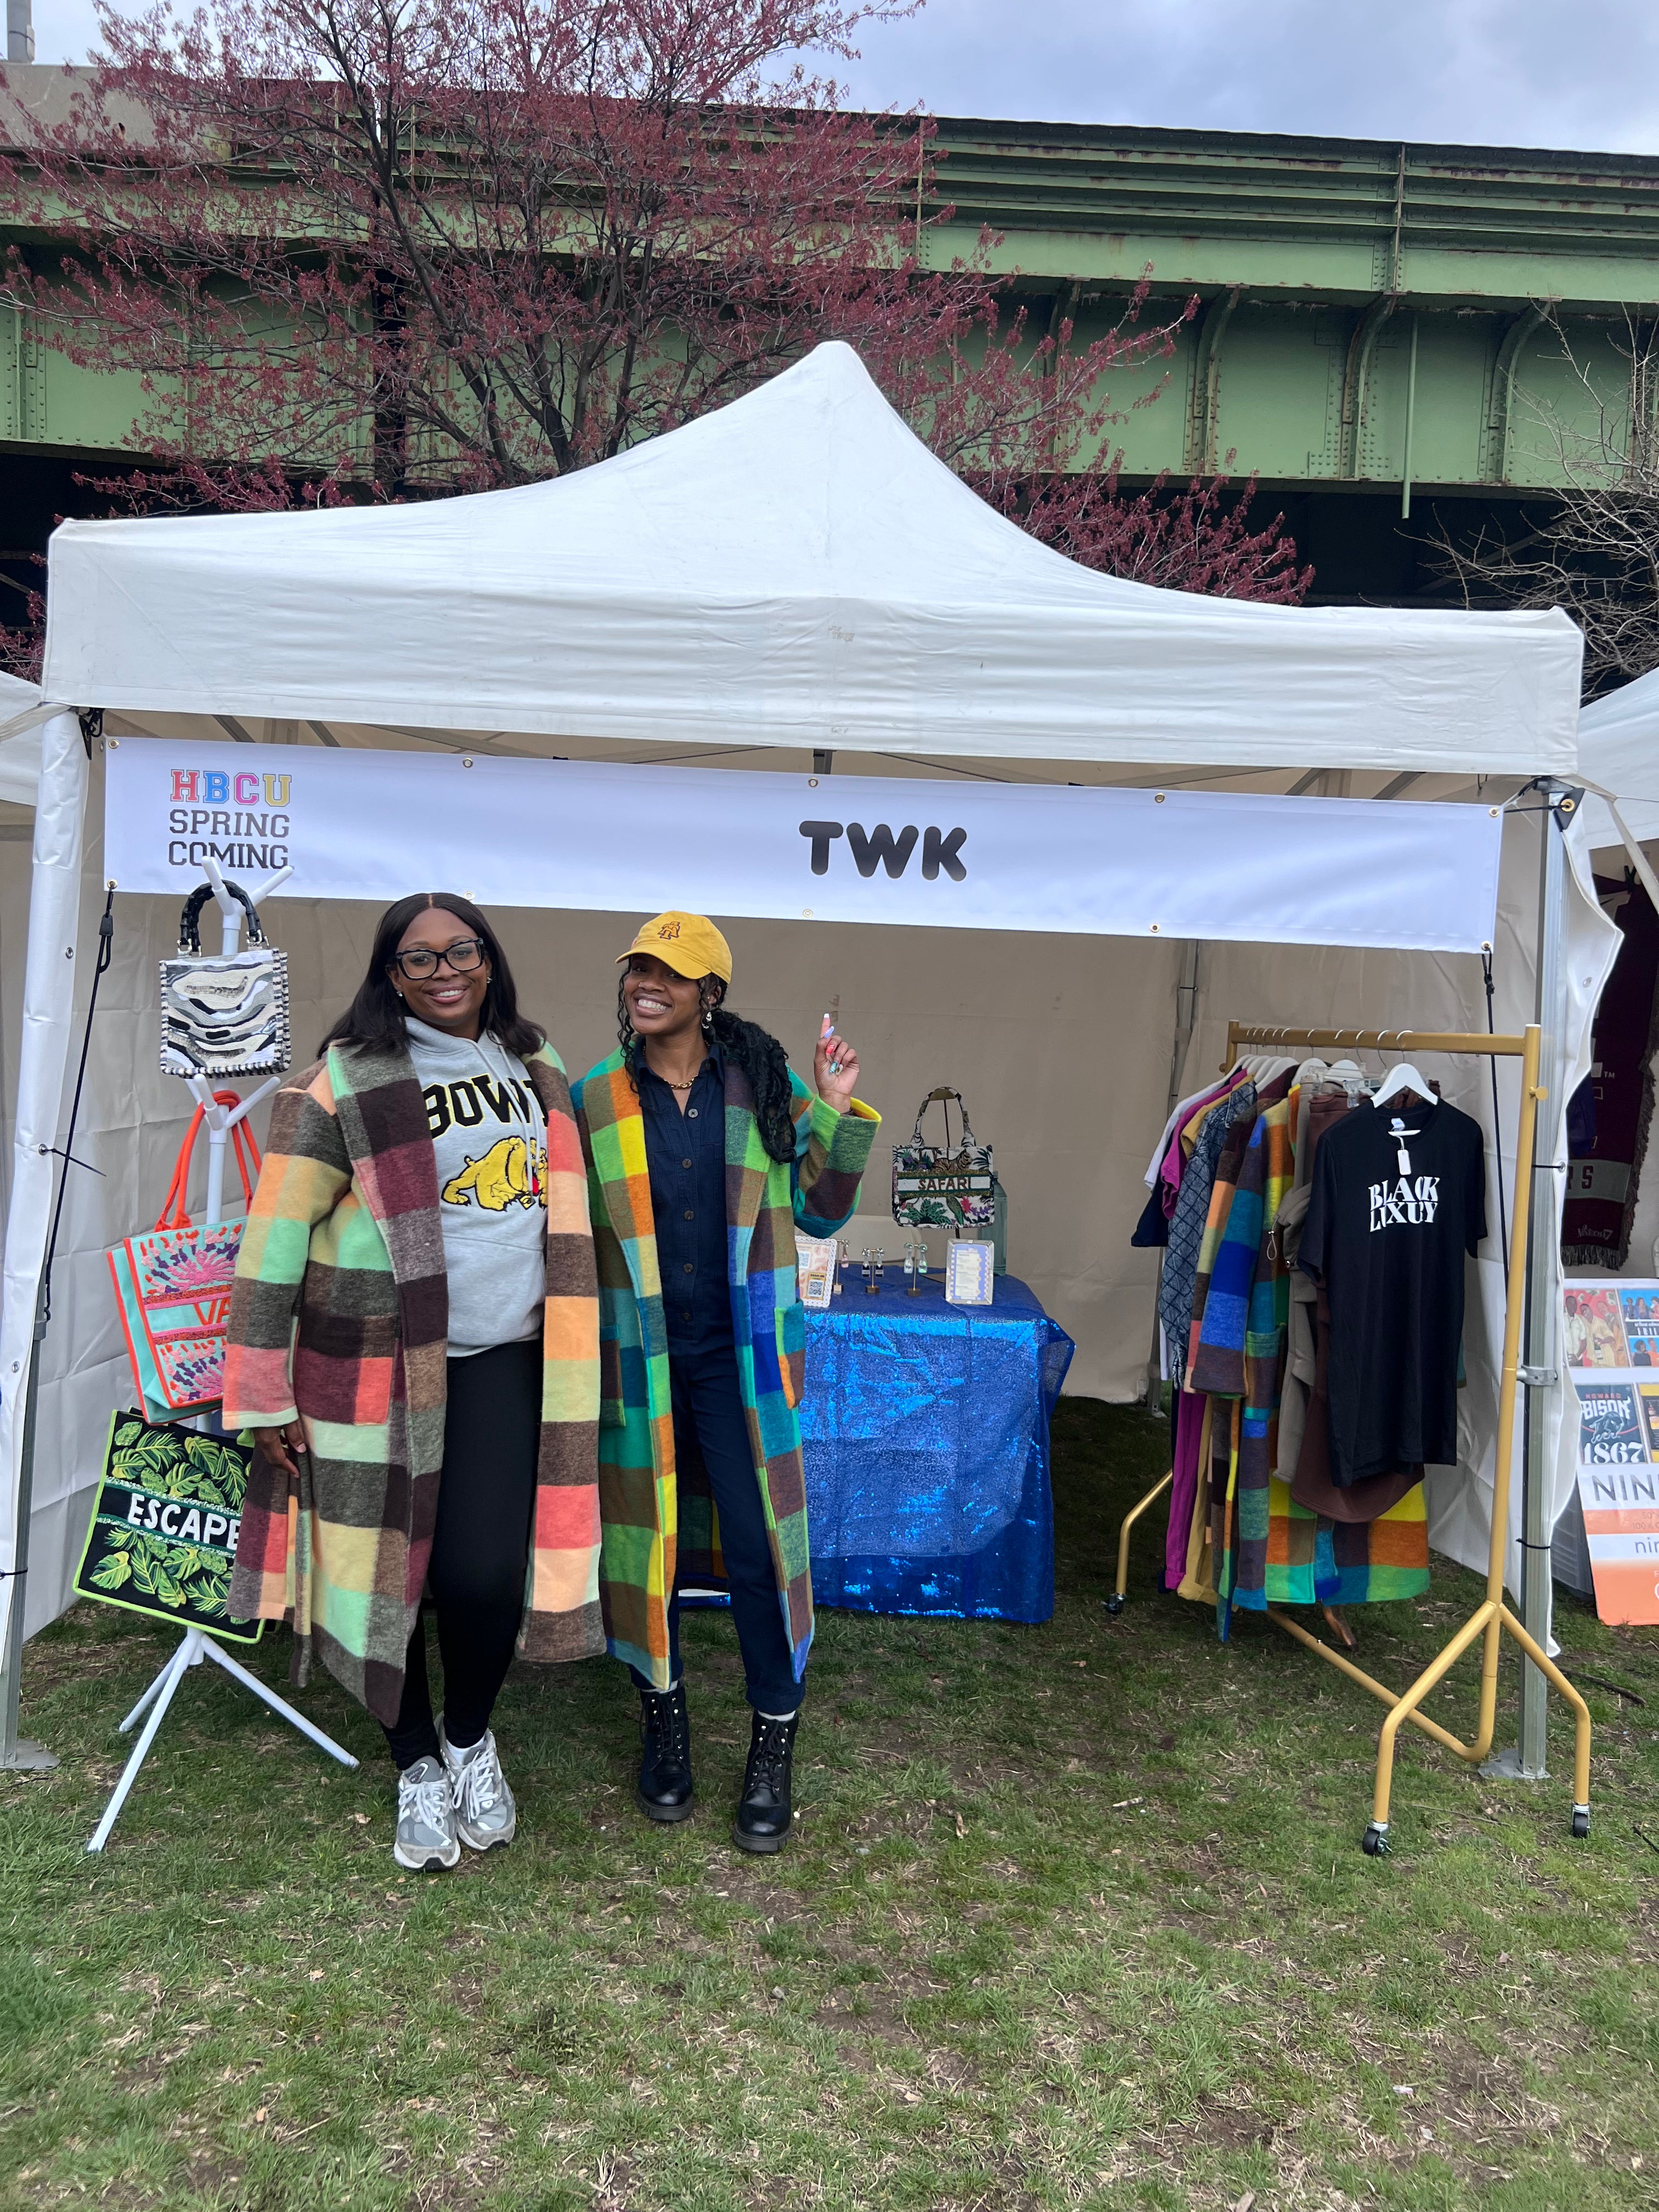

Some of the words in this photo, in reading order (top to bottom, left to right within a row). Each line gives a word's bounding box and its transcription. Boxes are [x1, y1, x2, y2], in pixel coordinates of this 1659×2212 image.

[171, 769, 292, 807] HBCU
[170, 809, 290, 838] SPRING
[168, 841, 289, 870] COMING
[799, 821, 967, 882] TWK
[918, 1177, 971, 1190] SAFARI
[1368, 1176, 1440, 1211] BLACK
[1580, 1396, 1630, 1420] BISON
[1584, 1442, 1643, 1464] 1867
[1592, 1474, 1659, 1501] NIN
[127, 1493, 241, 1550] ESCAPE
